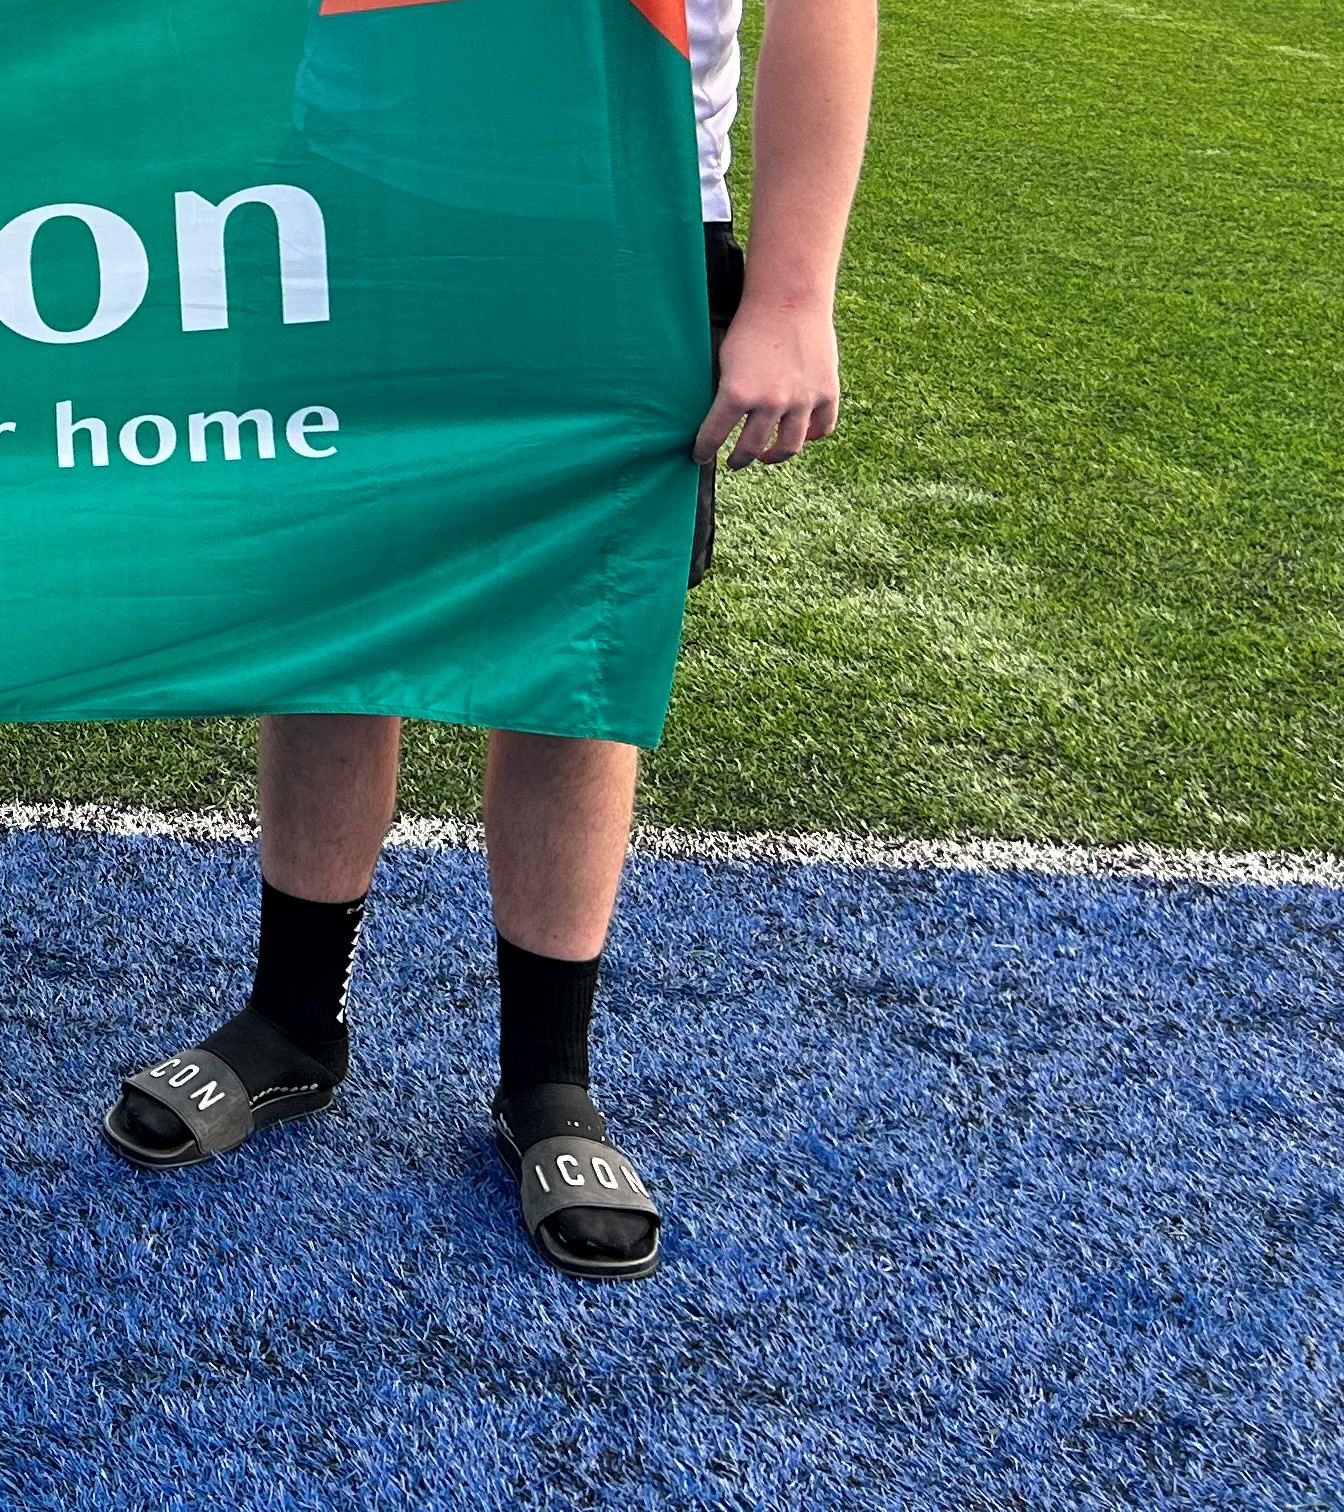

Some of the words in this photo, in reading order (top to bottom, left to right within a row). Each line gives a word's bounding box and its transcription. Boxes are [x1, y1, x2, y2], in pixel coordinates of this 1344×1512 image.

[57, 401, 338, 467] home
[149, 1057, 225, 1112] CON
[534, 1154, 650, 1199] ICON
